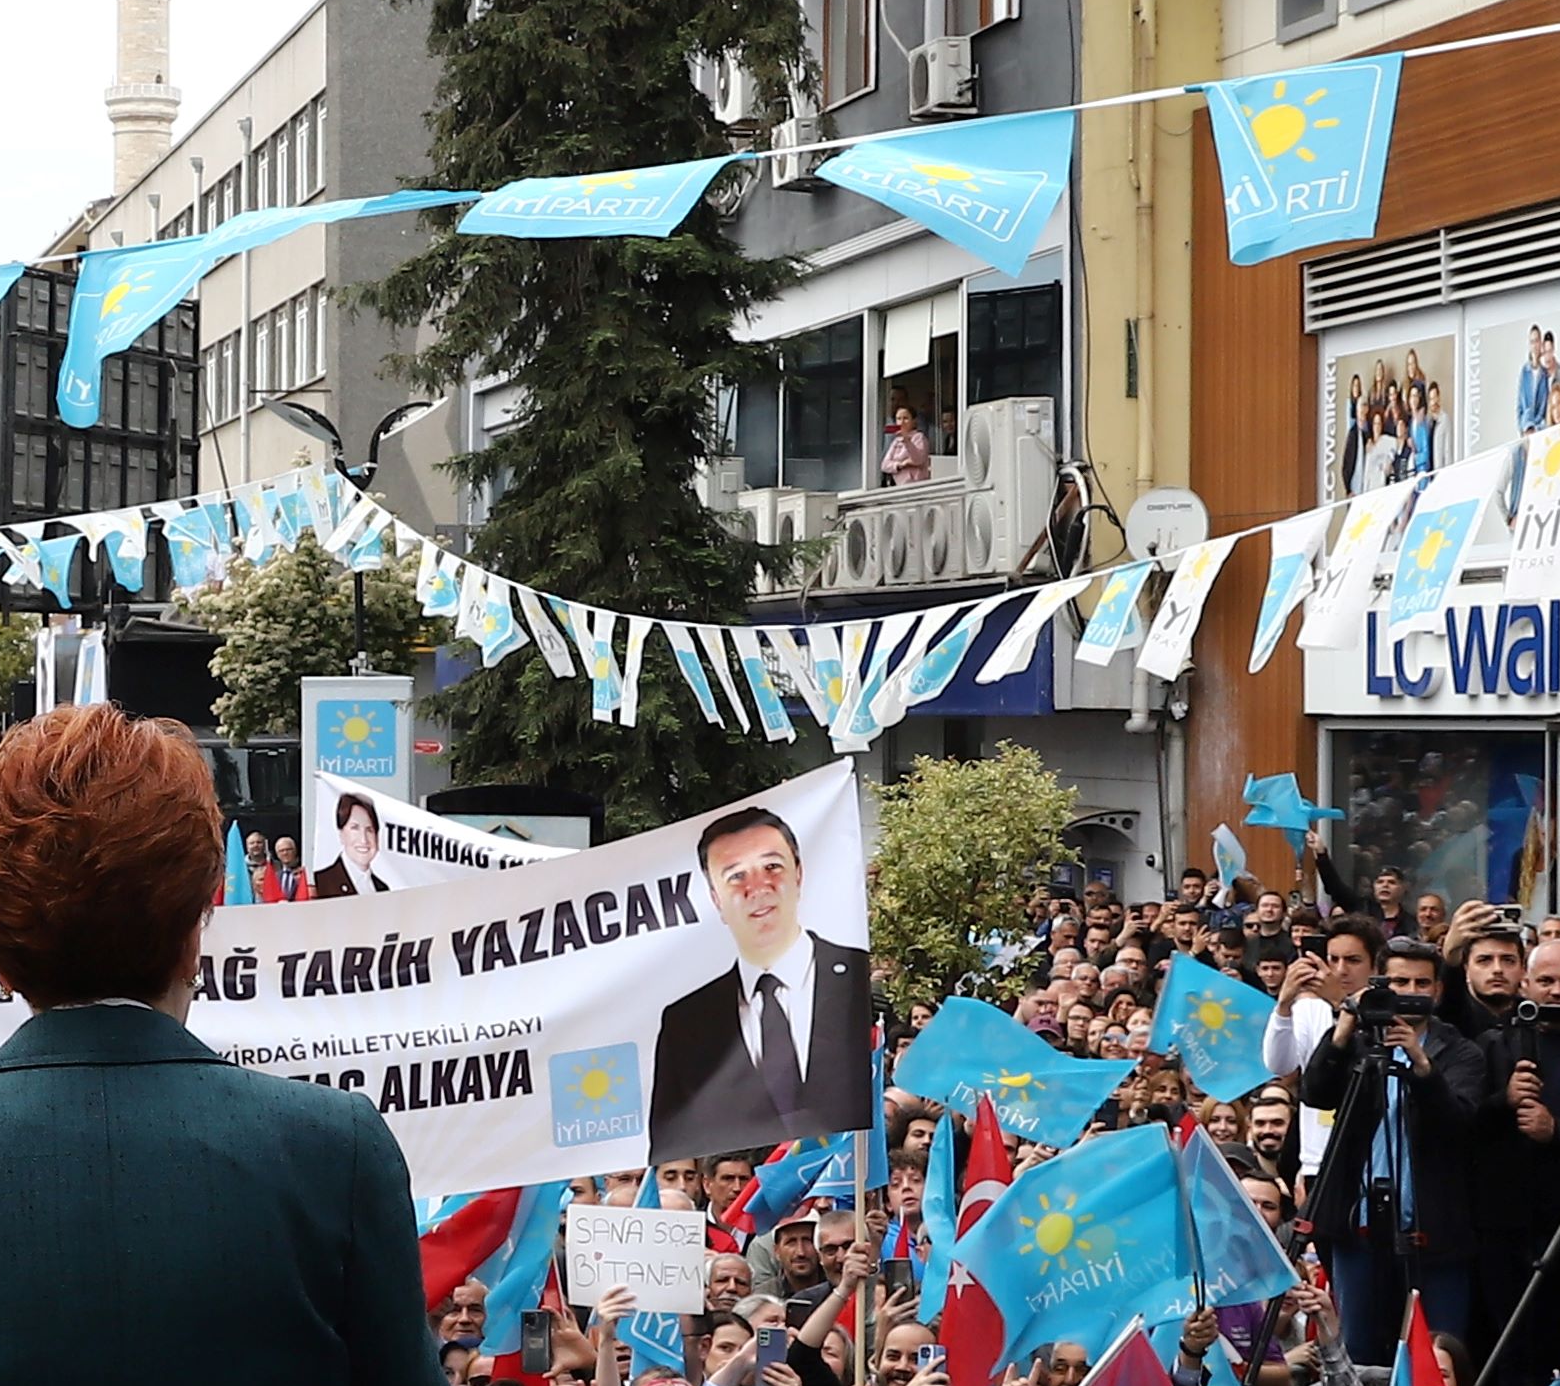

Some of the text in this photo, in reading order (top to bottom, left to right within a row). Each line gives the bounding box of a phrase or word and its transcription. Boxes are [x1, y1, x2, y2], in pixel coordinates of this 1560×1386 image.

[344, 755, 393, 774] PARTİ
[278, 933, 433, 999] TARİH
[452, 872, 702, 978] YAZACAK
[313, 1022, 471, 1059] MİLLETVEKİLİ
[475, 1015, 542, 1043] ADAYI
[379, 1049, 533, 1113] ALKAYA
[585, 1110, 644, 1138] PARTİ
[576, 1216, 643, 1245] SANA
